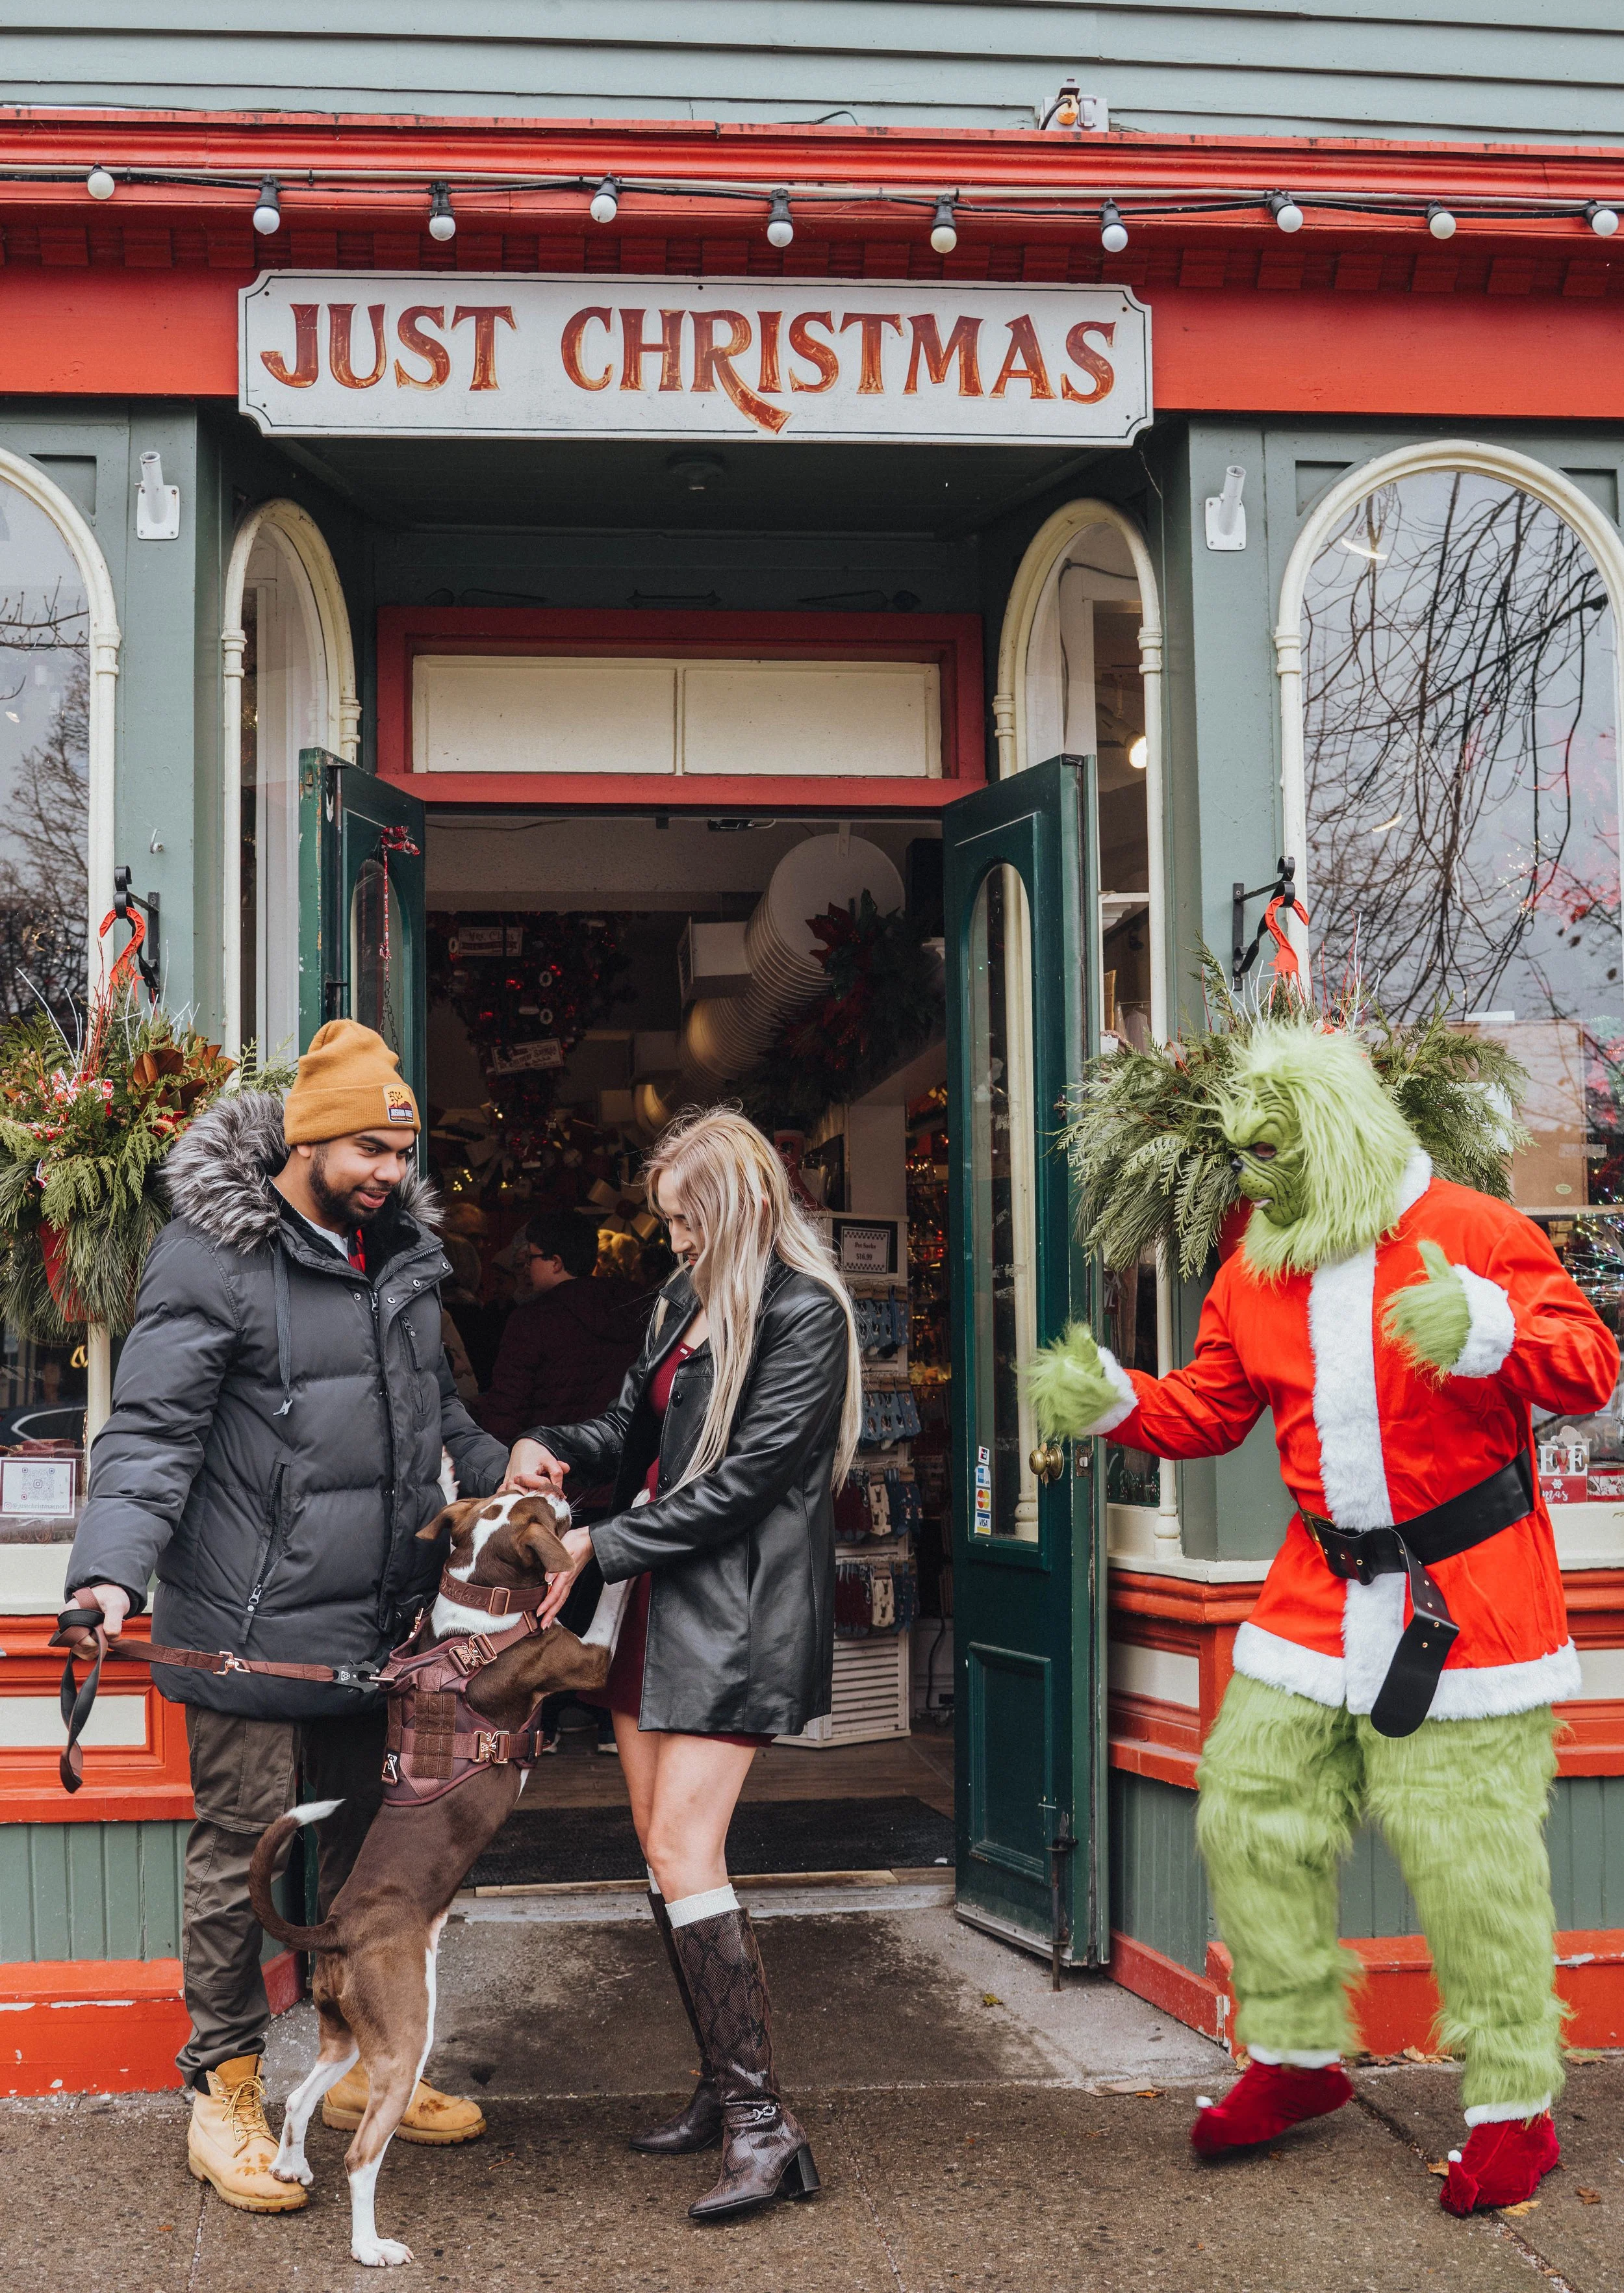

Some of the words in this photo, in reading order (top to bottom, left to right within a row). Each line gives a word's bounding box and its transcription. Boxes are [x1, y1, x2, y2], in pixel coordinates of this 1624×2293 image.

[260, 303, 518, 392] JUST
[561, 305, 1117, 435] CHRISTMAS
[979, 1518, 988, 1528] VISA
